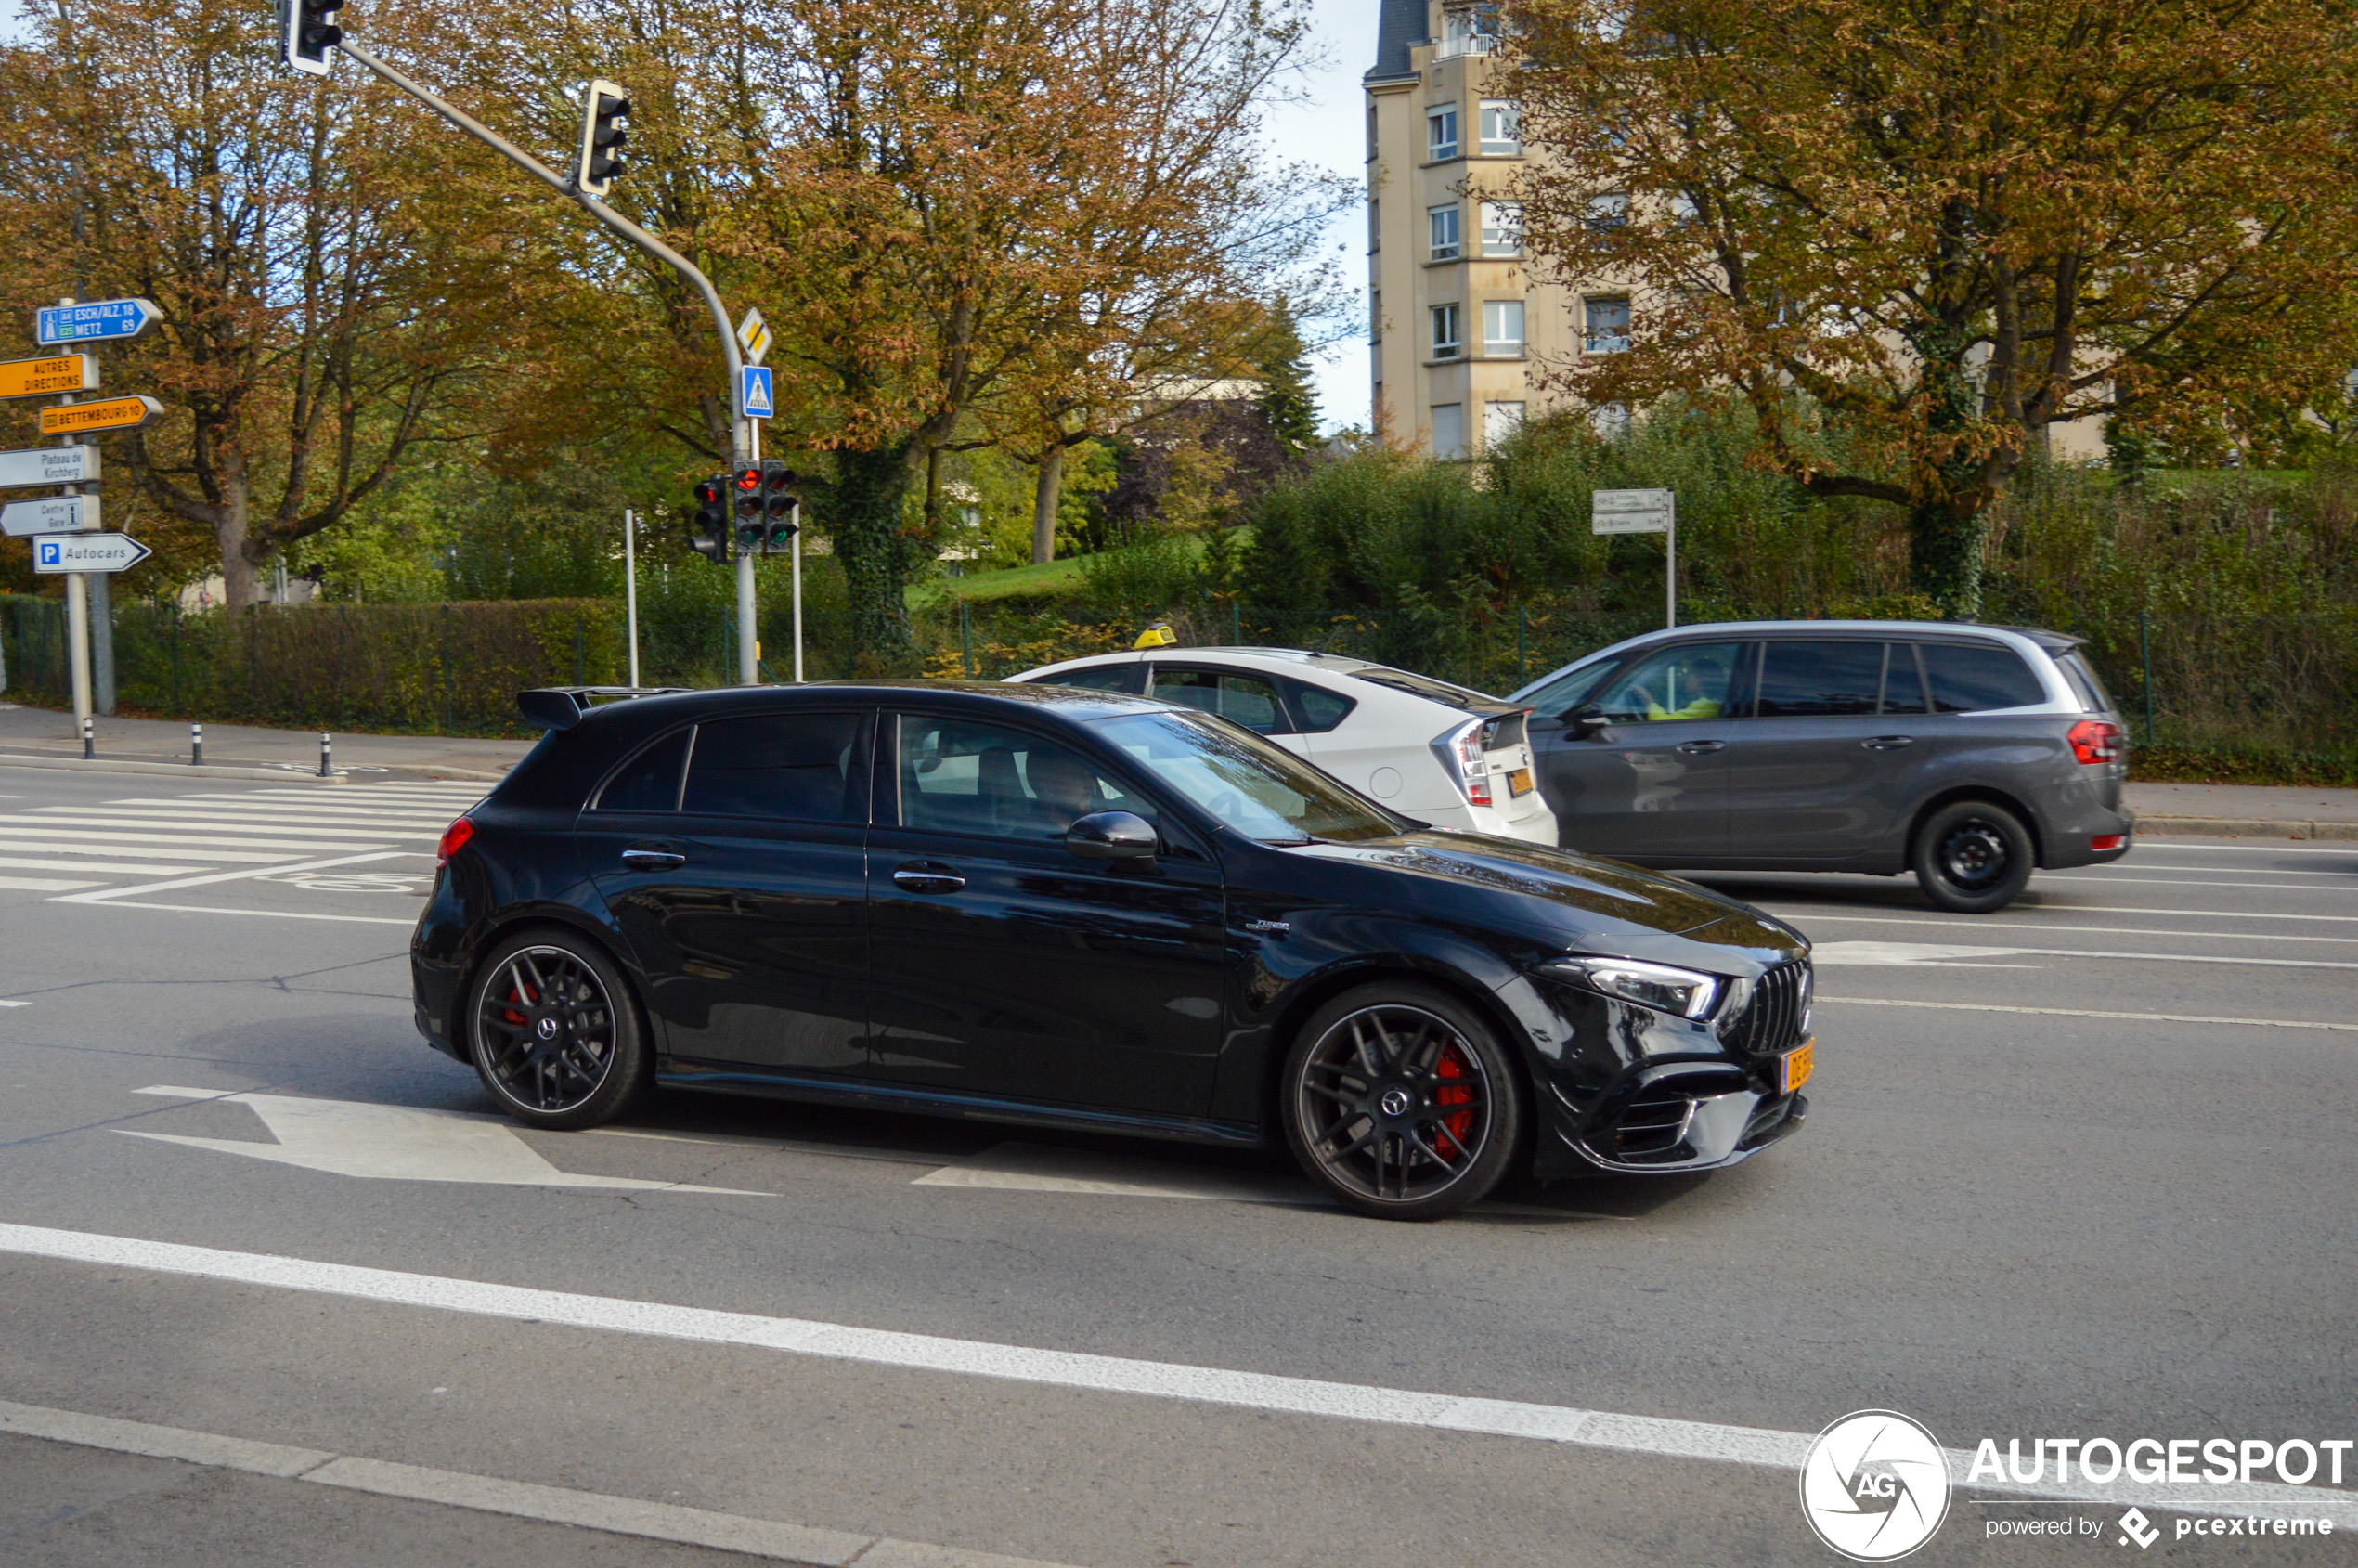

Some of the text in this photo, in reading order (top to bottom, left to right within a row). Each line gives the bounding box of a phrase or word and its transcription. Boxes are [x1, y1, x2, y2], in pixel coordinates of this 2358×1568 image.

[75, 306, 122, 320] ESCH/ALZ.
[123, 304, 134, 316] 18
[75, 322, 102, 336] METZ
[122, 319, 135, 331] 69
[34, 360, 71, 374] AUTRES
[24, 375, 81, 391] DIRECTIONS
[59, 407, 128, 425] BETTEMBOURG
[129, 405, 140, 417] 10
[42, 453, 81, 464] Plateau de
[44, 467, 81, 479] Kirchberg
[42, 505, 64, 514] Centre
[49, 518, 65, 527] Gare
[65, 548, 126, 559] Autocars
